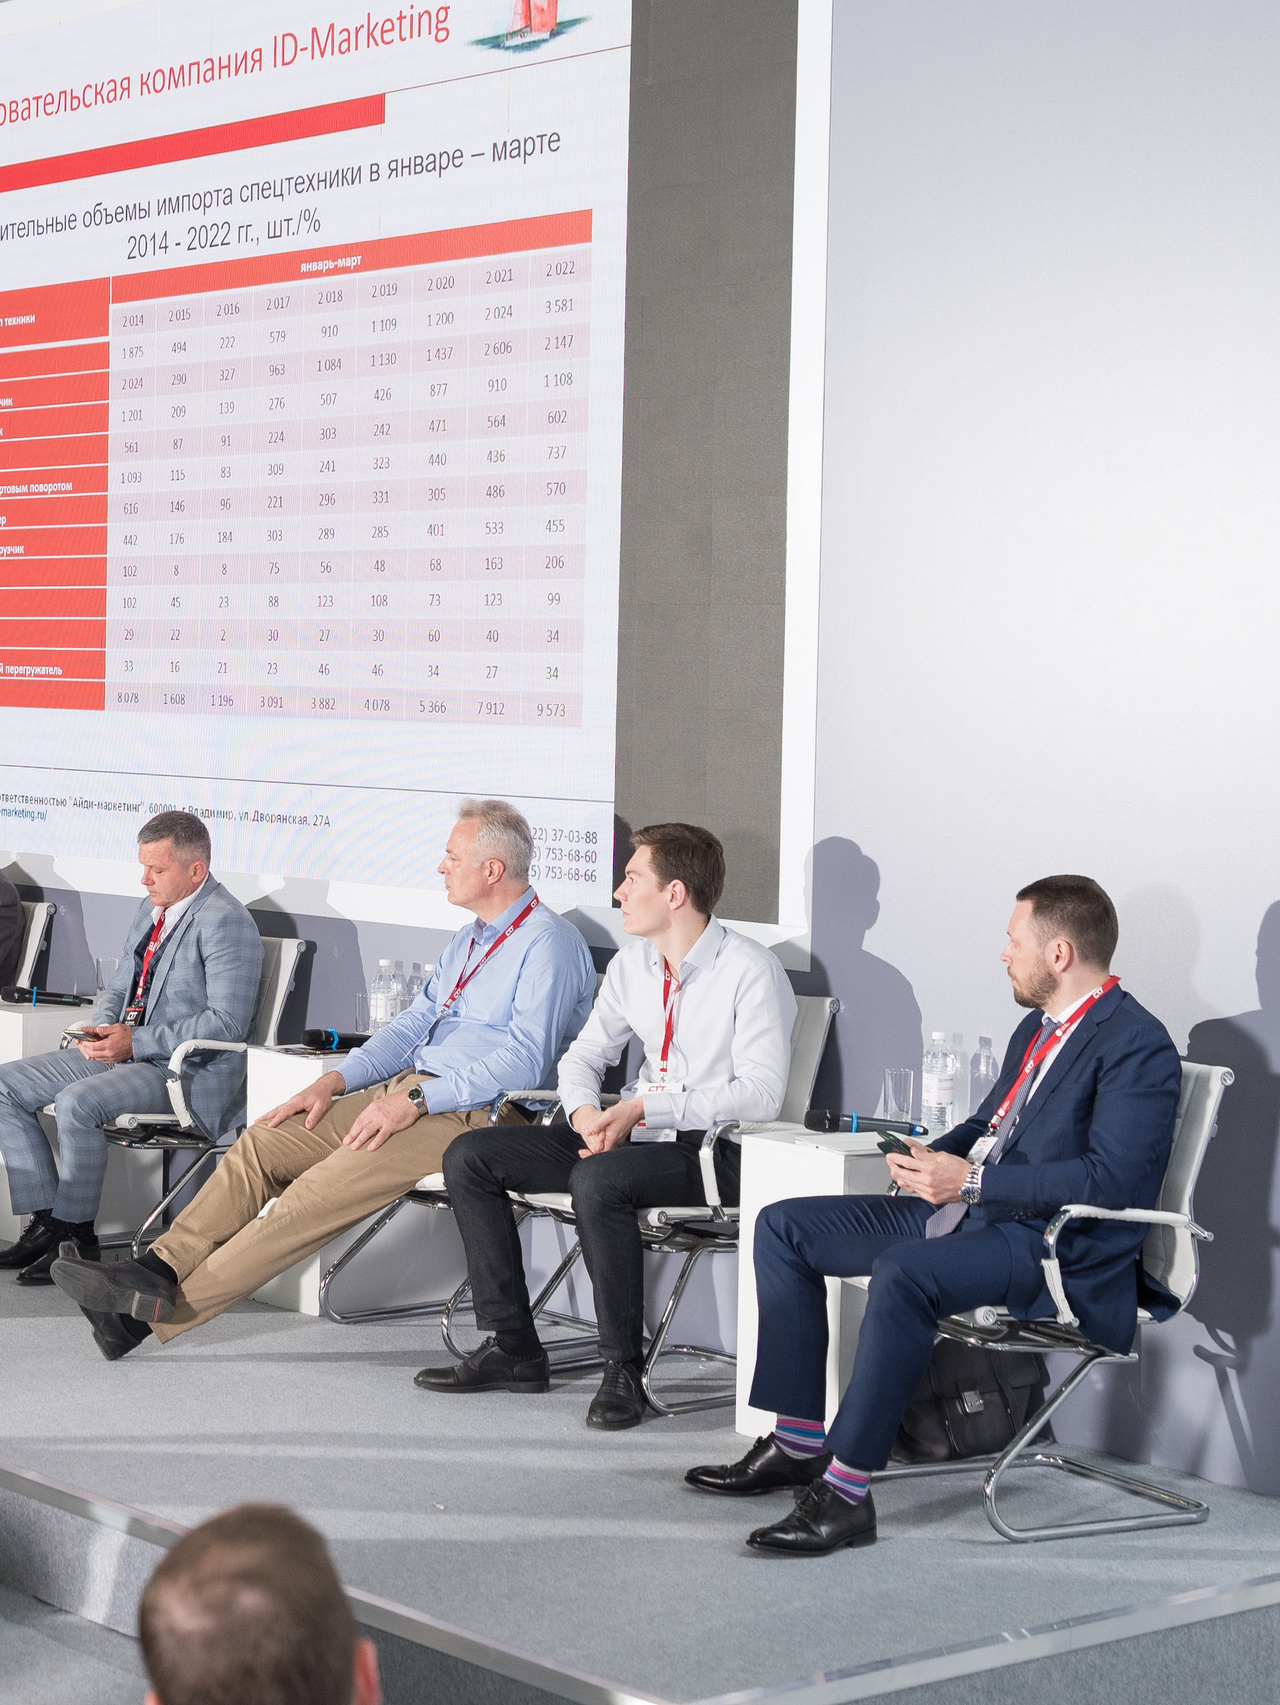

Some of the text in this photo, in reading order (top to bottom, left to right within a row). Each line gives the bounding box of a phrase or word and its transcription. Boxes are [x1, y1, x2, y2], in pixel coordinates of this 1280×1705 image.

[139, 46, 264, 97] компания
[272, 3, 451, 70] ID-Marketing
[82, 200, 151, 231] объемы
[157, 187, 234, 223] импорта
[239, 164, 362, 207] спецтехники
[369, 163, 380, 183] в
[387, 147, 464, 185] январе
[491, 127, 562, 167] марте
[127, 229, 169, 260] 2014
[186, 220, 231, 252] 2022
[237, 221, 261, 246] гг.,
[267, 206, 322, 240] шт./%
[300, 254, 363, 275] январь-март
[4, 312, 36, 327] техники
[171, 324, 339, 354] 494 222 579 910
[170, 363, 286, 386] 290 327 963
[170, 377, 508, 419] 209 139 276 507 426 877 910
[124, 409, 568, 454] 561 87 91 224 303 242 471 564 602
[170, 445, 567, 482] 115 83 309 241 323 440 436 737
[29, 480, 73, 494] поворотом
[123, 481, 567, 515] 616 146 96 221 296 331 305 486 570
[123, 519, 566, 546] 442 176 184 303 289 285 401 533 455
[123, 555, 565, 578] 102 75 56 48 68 163 206
[122, 592, 562, 609] 102 45 23 88 123 108 73 123 99
[5, 664, 63, 679] перегружатель
[313, 814, 331, 828] 27А
[551, 828, 598, 845] 37-03-88
[545, 847, 597, 864] 753-68-60
[545, 865, 597, 883] 753-68-66
